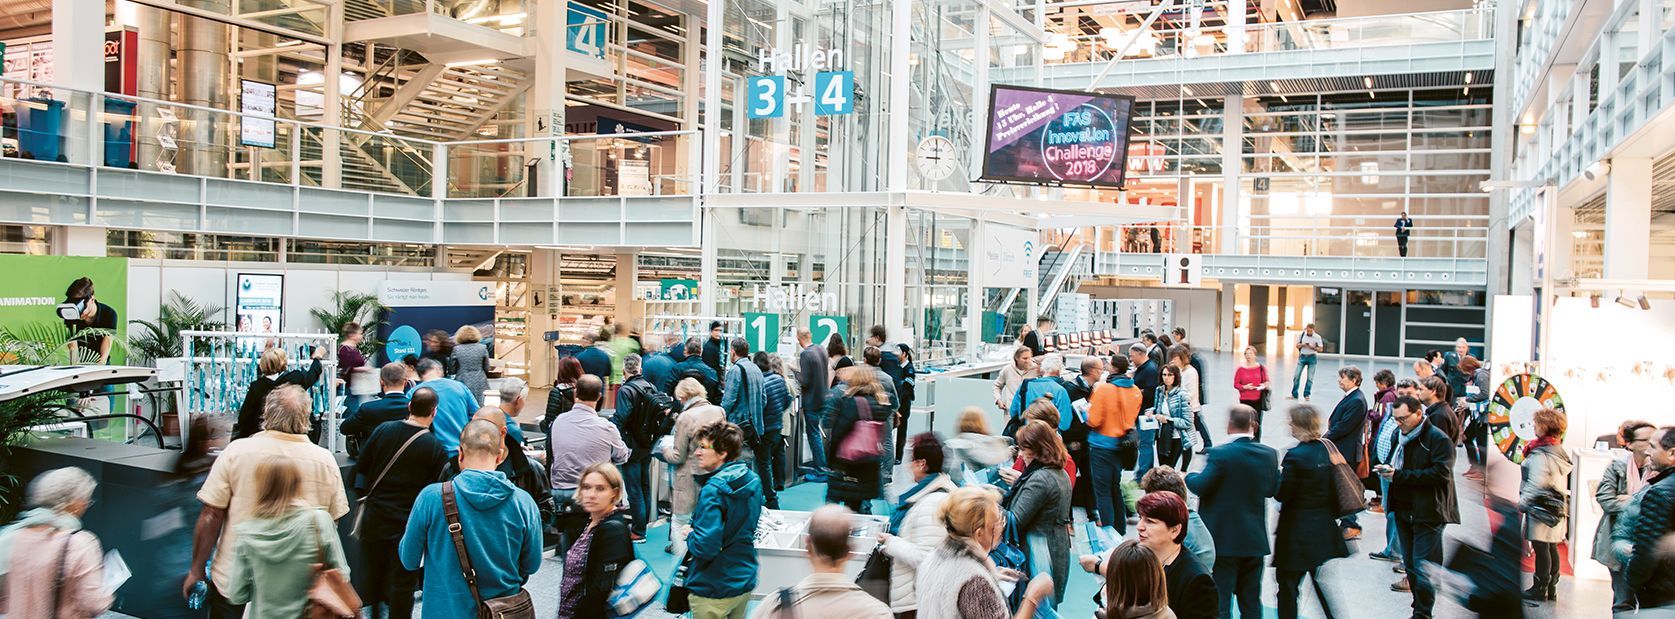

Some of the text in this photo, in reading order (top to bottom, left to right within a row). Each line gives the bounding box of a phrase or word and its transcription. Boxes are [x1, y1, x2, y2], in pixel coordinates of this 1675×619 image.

[575, 15, 600, 57] 4
[758, 43, 843, 74] Hallen
[755, 78, 777, 116] 3
[821, 73, 847, 112] 4
[997, 101, 1021, 118] Heute
[1024, 99, 1047, 115] Halle
[1063, 111, 1092, 127] IFAS
[1046, 143, 1112, 162] Challenge
[1065, 160, 1096, 176] 2018
[0, 296, 56, 306] ANIMATION
[753, 283, 837, 312] Hallen
[751, 315, 838, 354] 1 2
